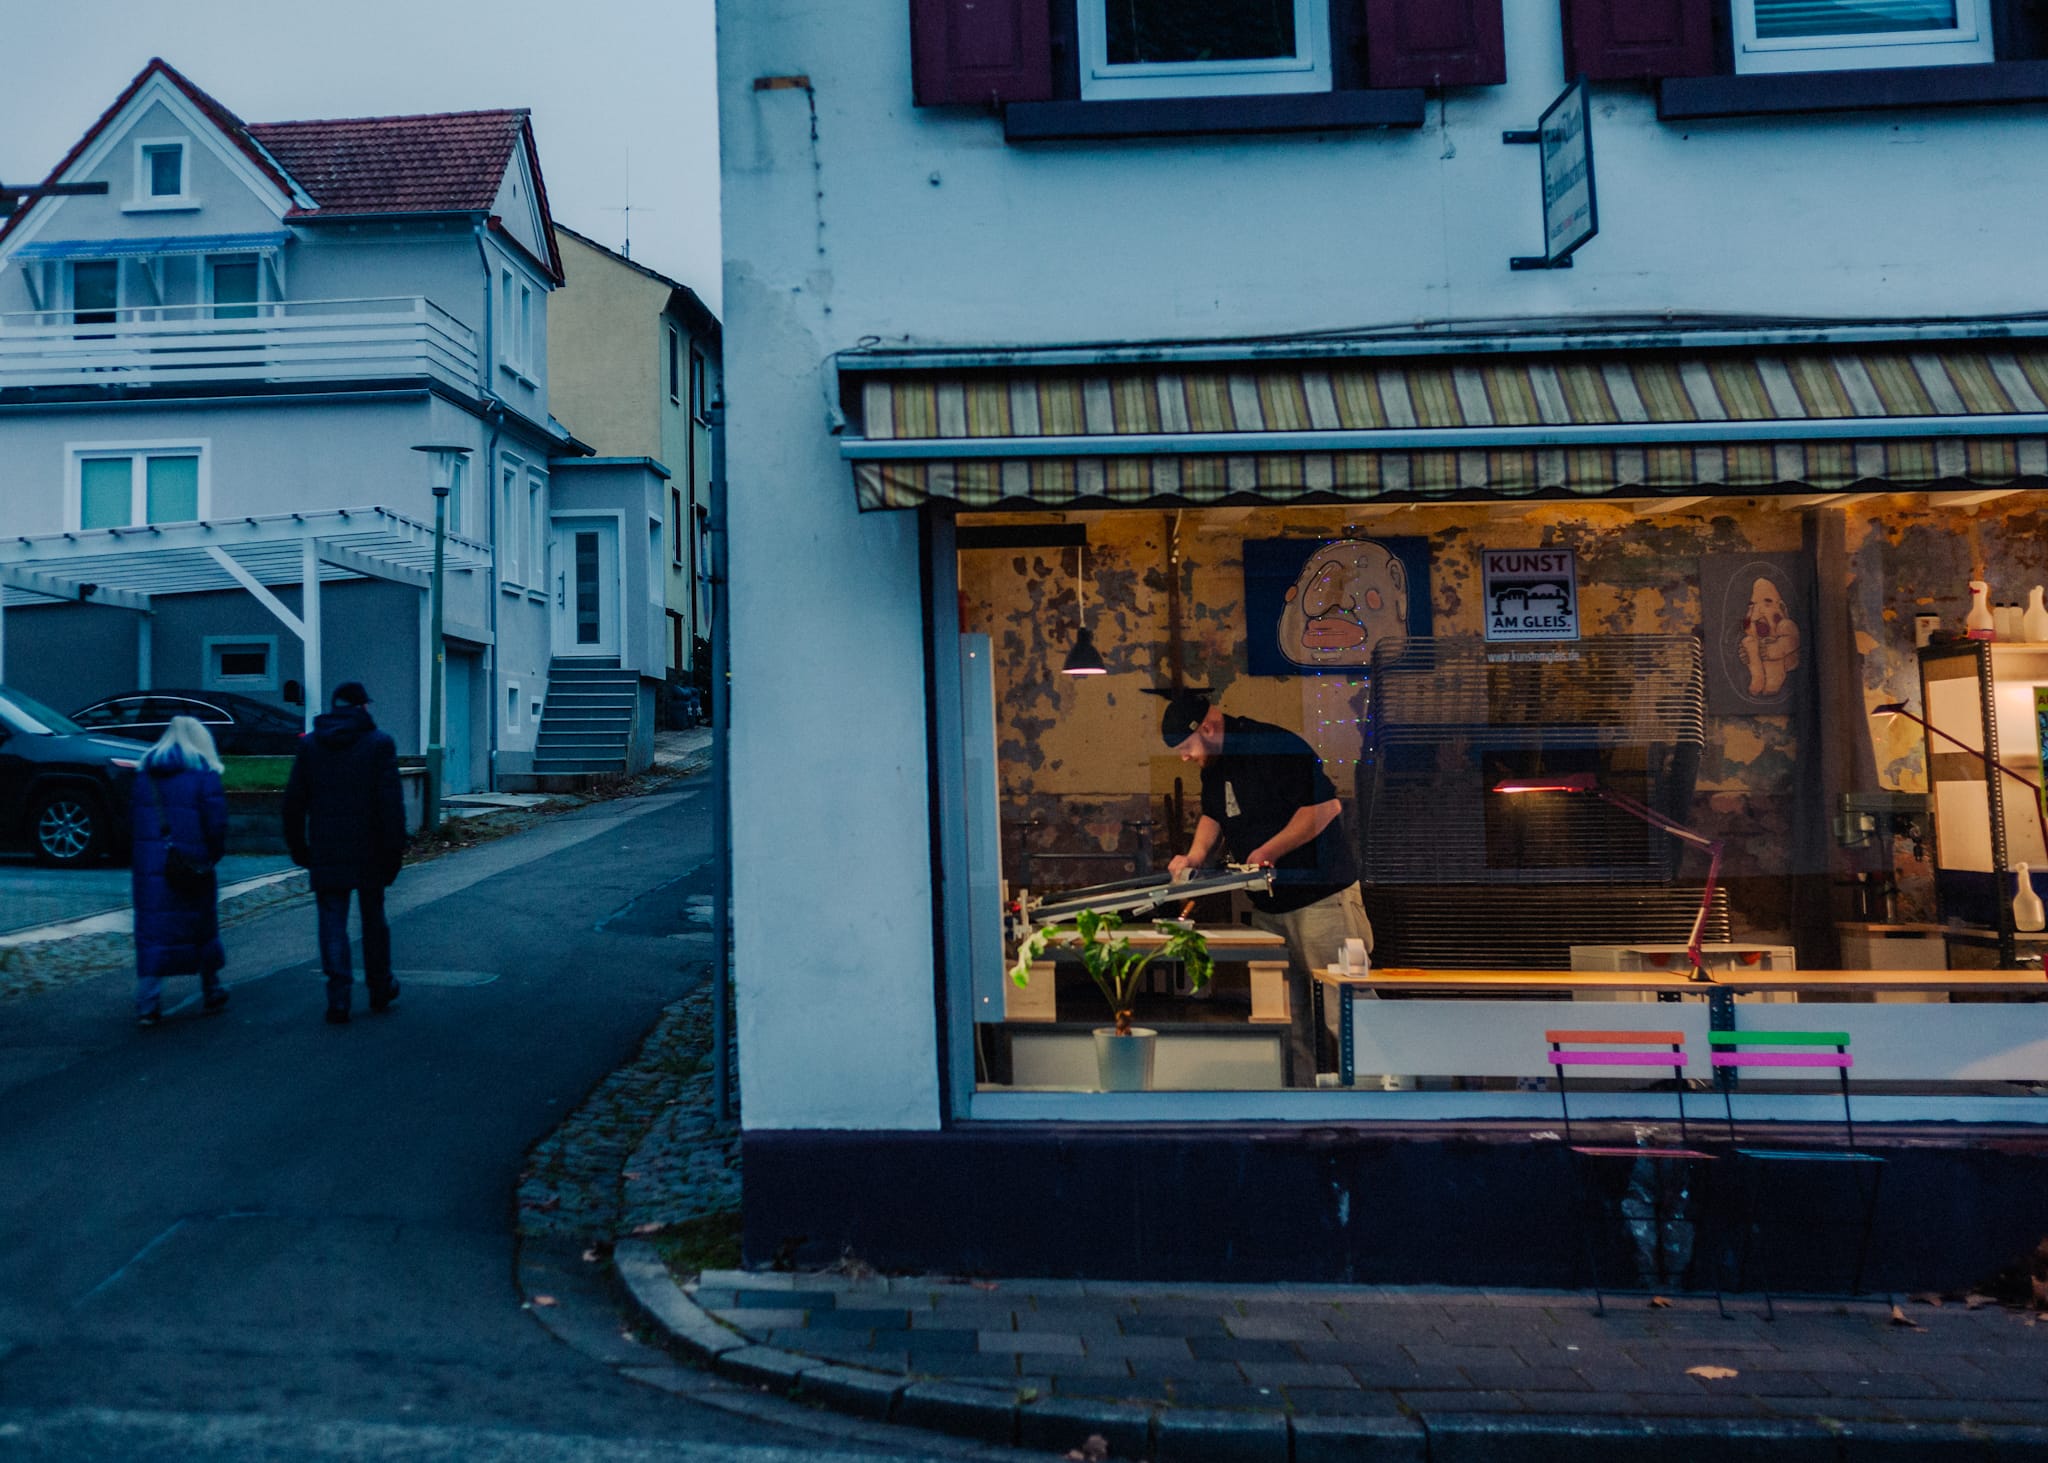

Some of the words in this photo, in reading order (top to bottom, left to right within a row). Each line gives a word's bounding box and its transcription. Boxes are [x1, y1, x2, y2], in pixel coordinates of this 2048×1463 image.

[1489, 555, 1568, 573] KUNST
[1494, 617, 1518, 628] AM
[1523, 615, 1571, 628] GLEIS.
